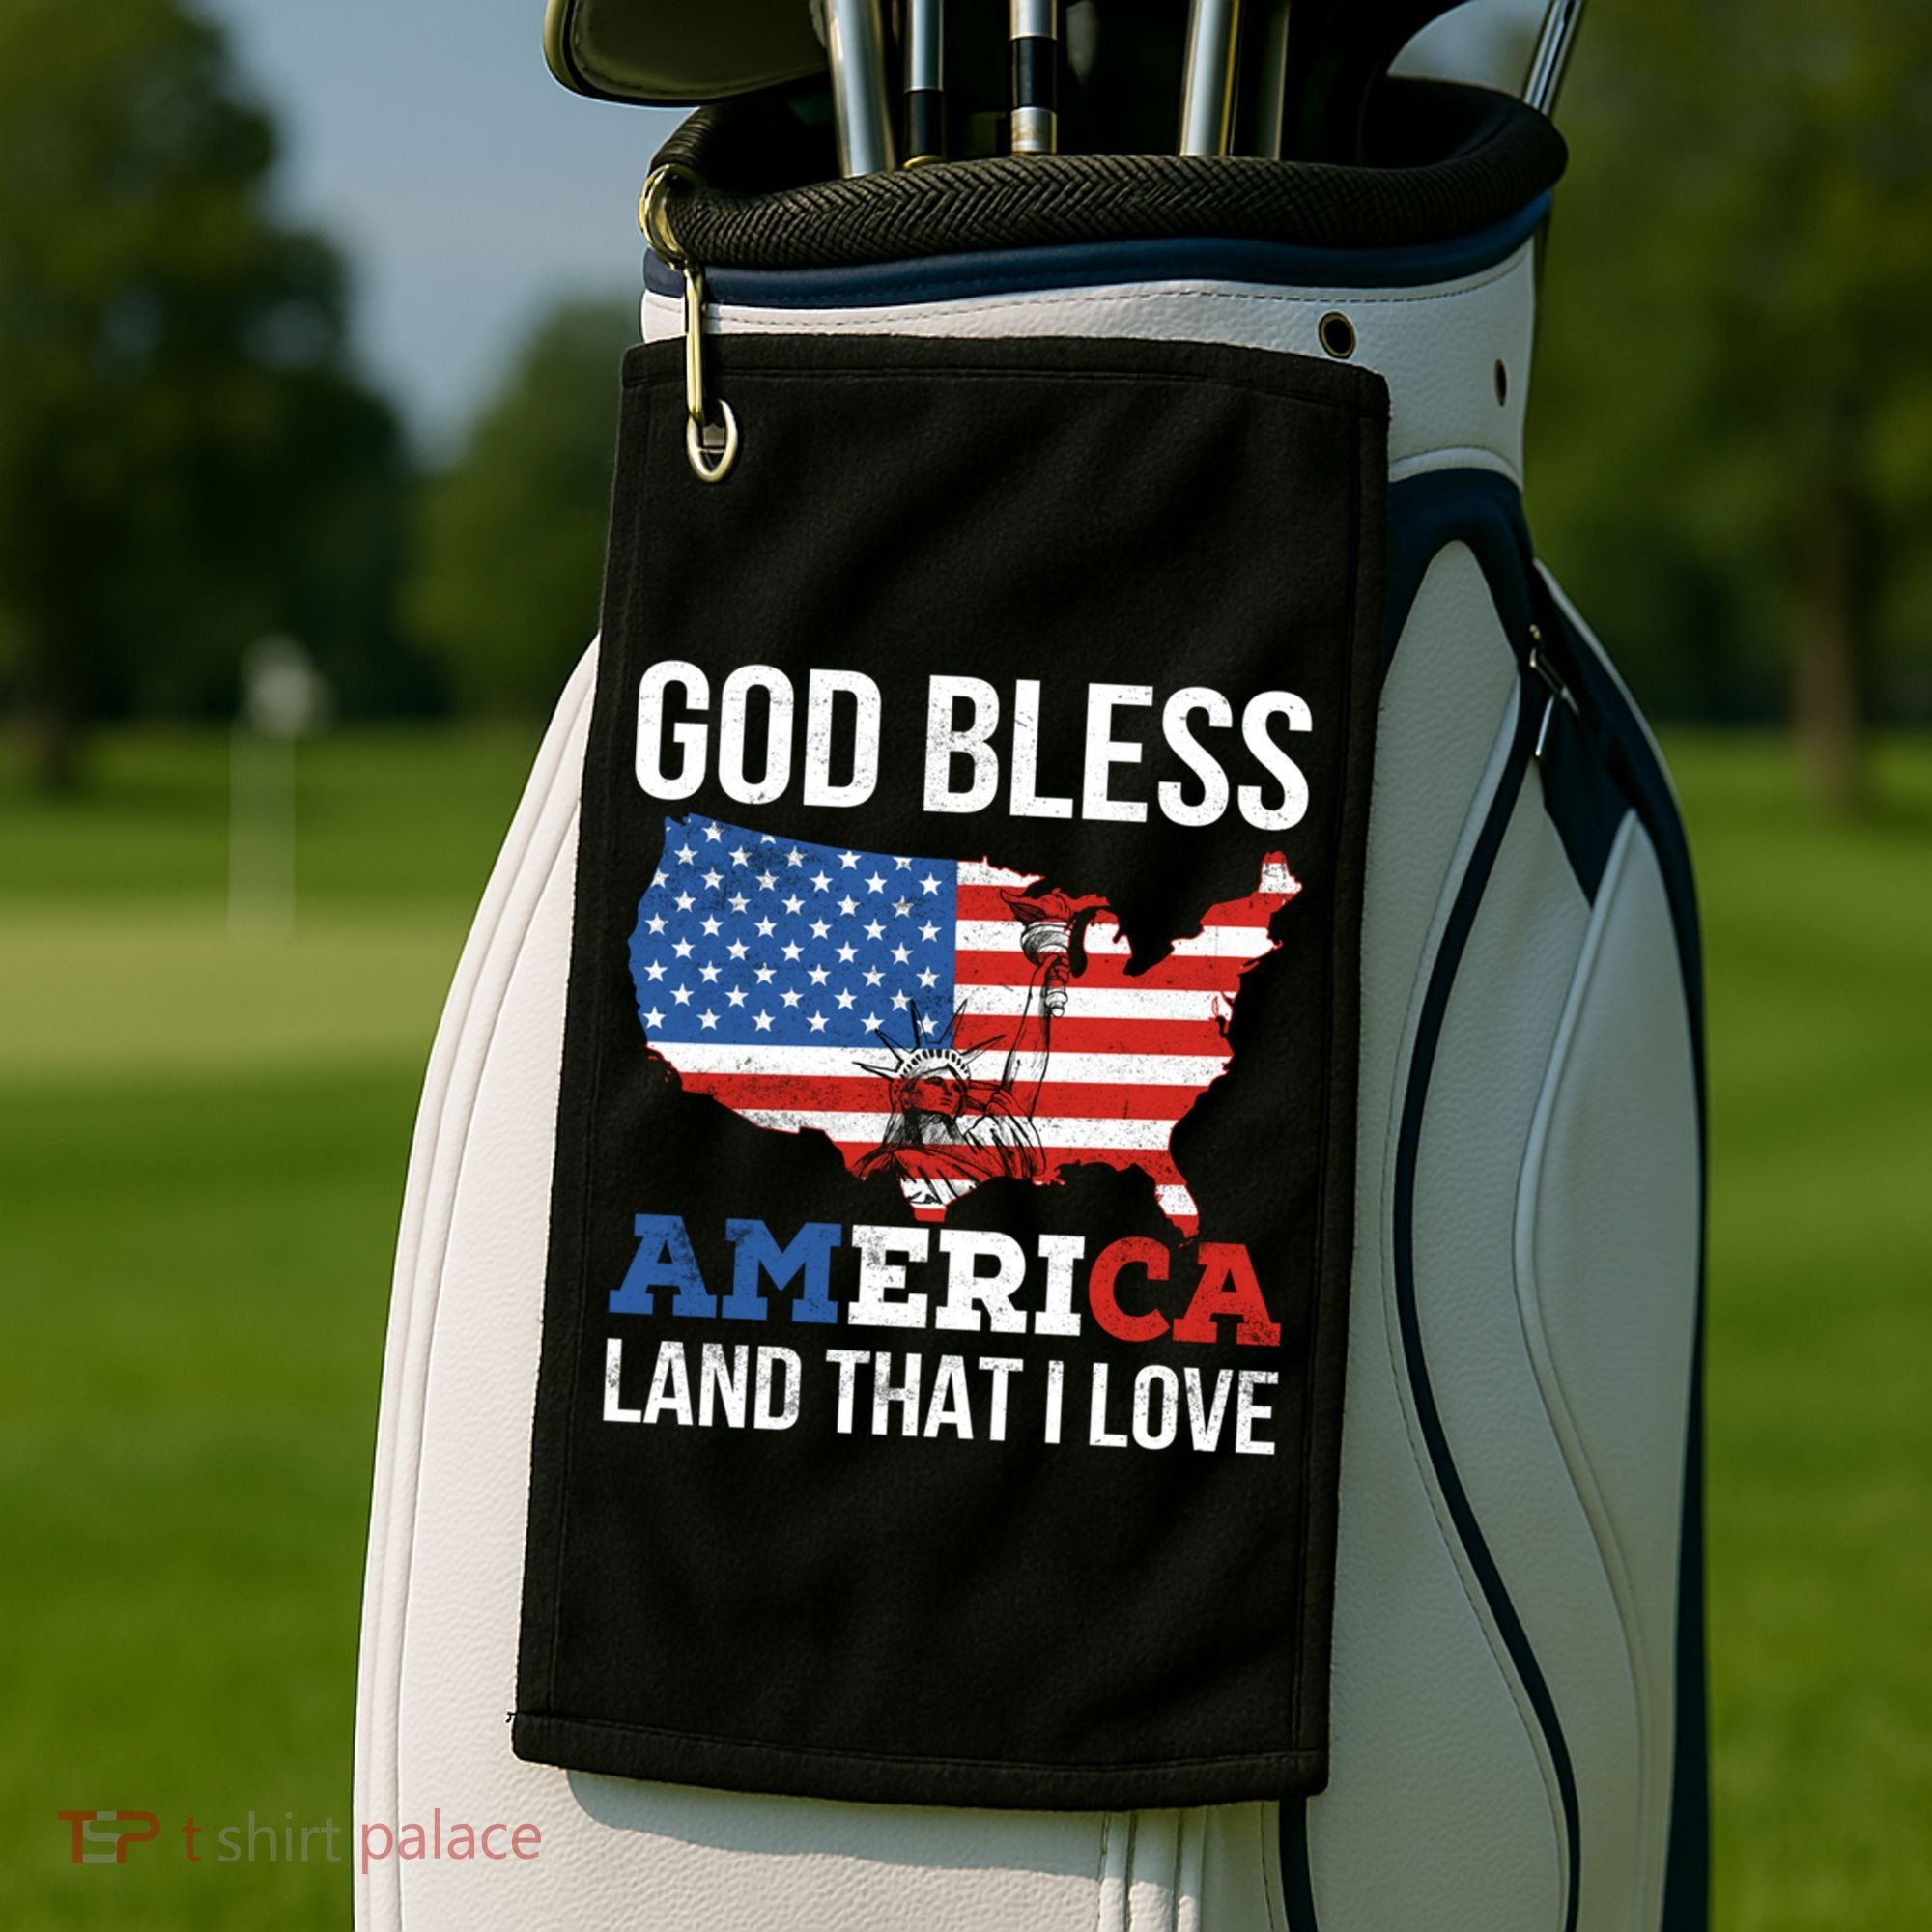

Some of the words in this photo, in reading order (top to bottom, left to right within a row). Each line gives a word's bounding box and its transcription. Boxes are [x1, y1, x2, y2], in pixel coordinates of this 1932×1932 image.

[635, 659, 882, 808] GOD
[923, 674, 1313, 831] BLESS
[609, 1213, 1281, 1347] AMERICA
[602, 1337, 802, 1431] LAND
[825, 1349, 1024, 1442] THAT
[1044, 1359, 1065, 1445] I
[1089, 1362, 1279, 1456] LOVE
